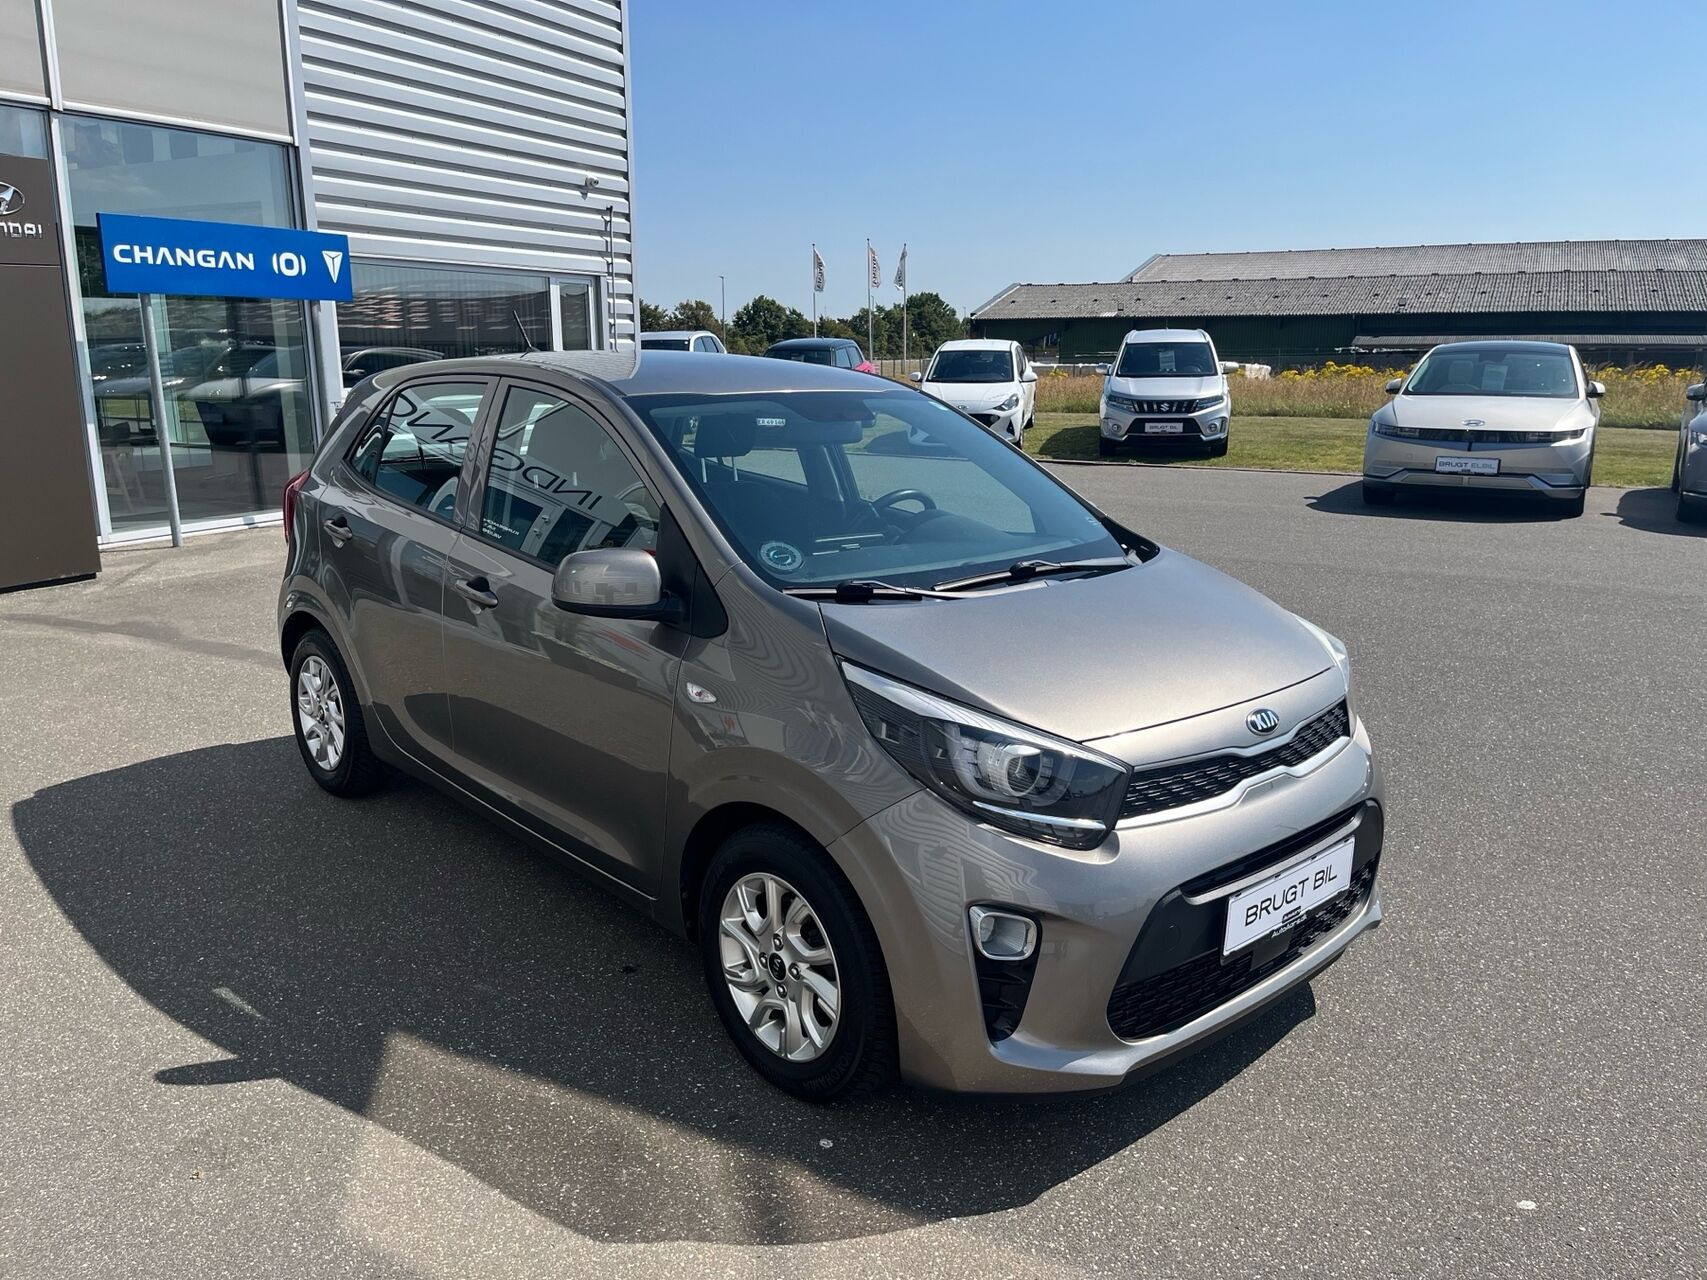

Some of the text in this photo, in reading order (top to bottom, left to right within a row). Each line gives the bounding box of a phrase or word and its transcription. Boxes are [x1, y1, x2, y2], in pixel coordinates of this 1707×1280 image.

[113, 244, 255, 271] CHANGAN
[1251, 710, 1278, 731] KIA
[1244, 876, 1309, 927] BRUGT
[1313, 864, 1338, 891] BIL
